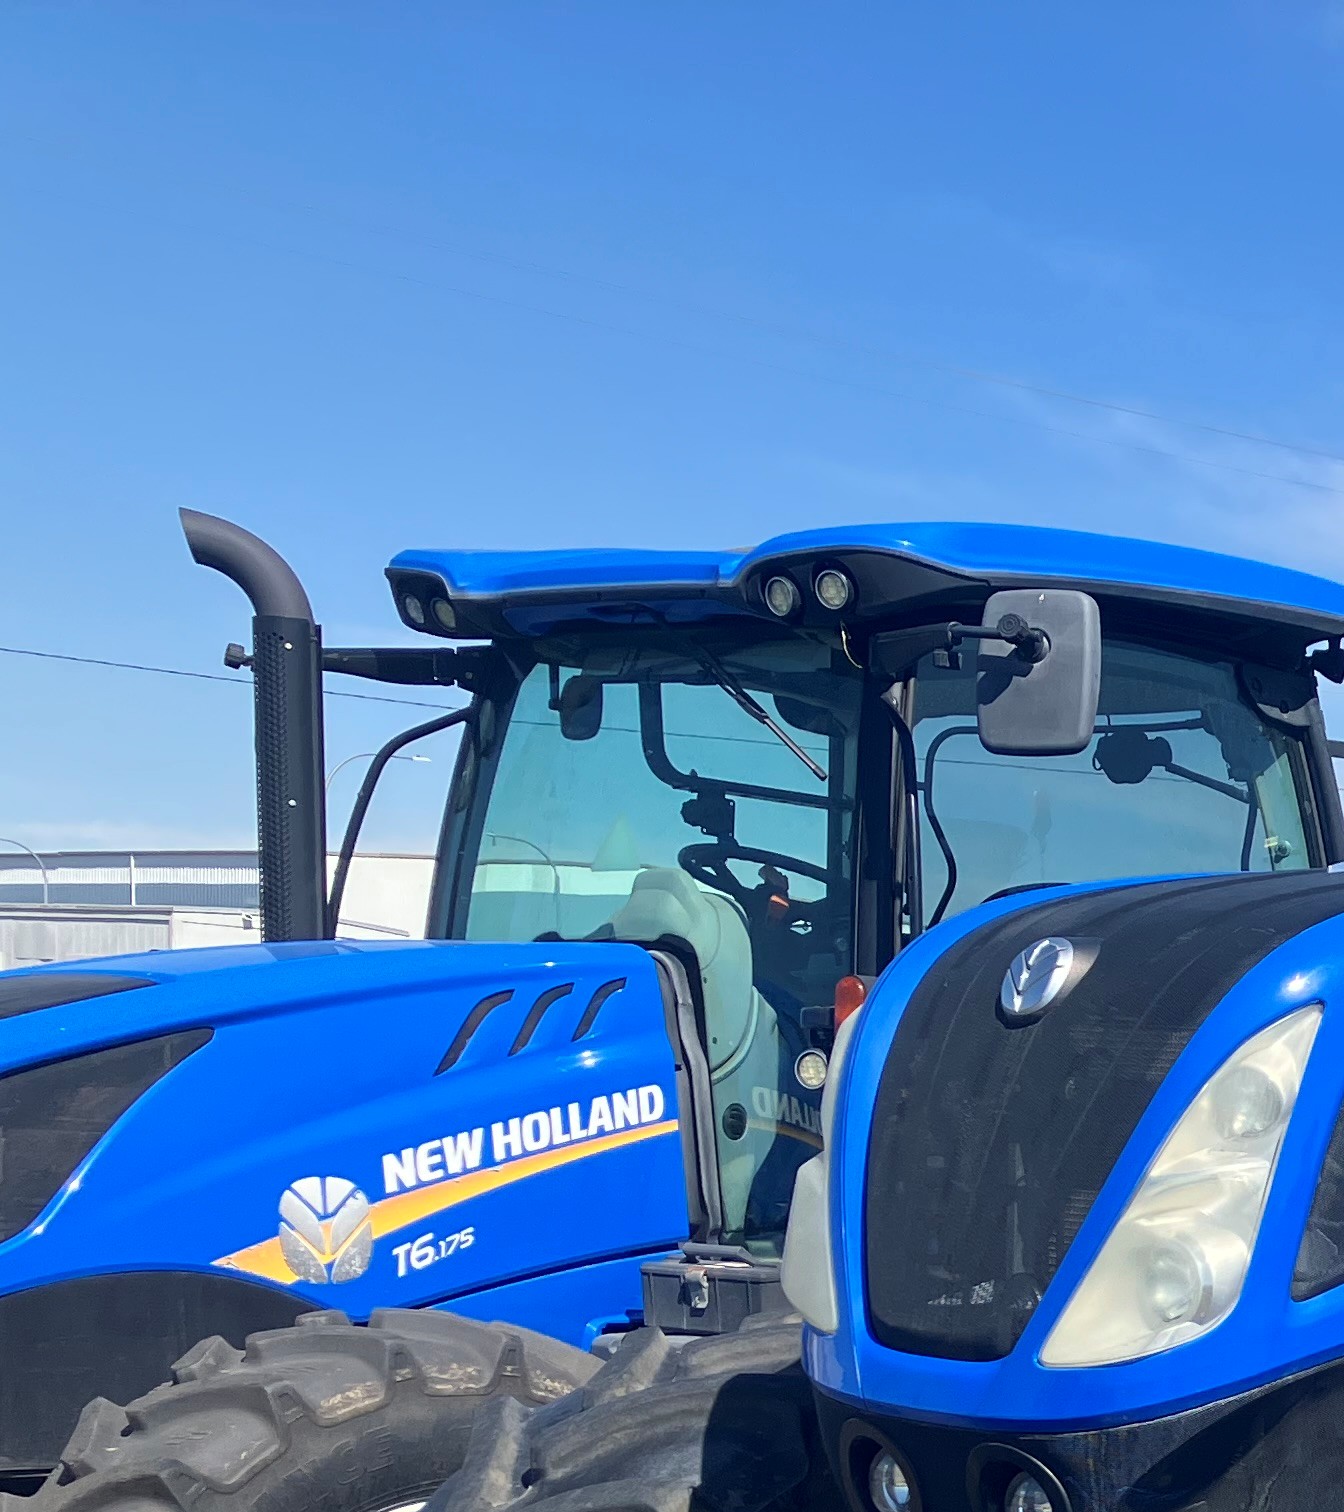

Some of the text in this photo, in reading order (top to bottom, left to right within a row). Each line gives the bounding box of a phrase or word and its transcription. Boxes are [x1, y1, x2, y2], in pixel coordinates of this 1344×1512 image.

[381, 1084, 664, 1194] NEW HOLLAND
[391, 1227, 476, 1279] T6.175
